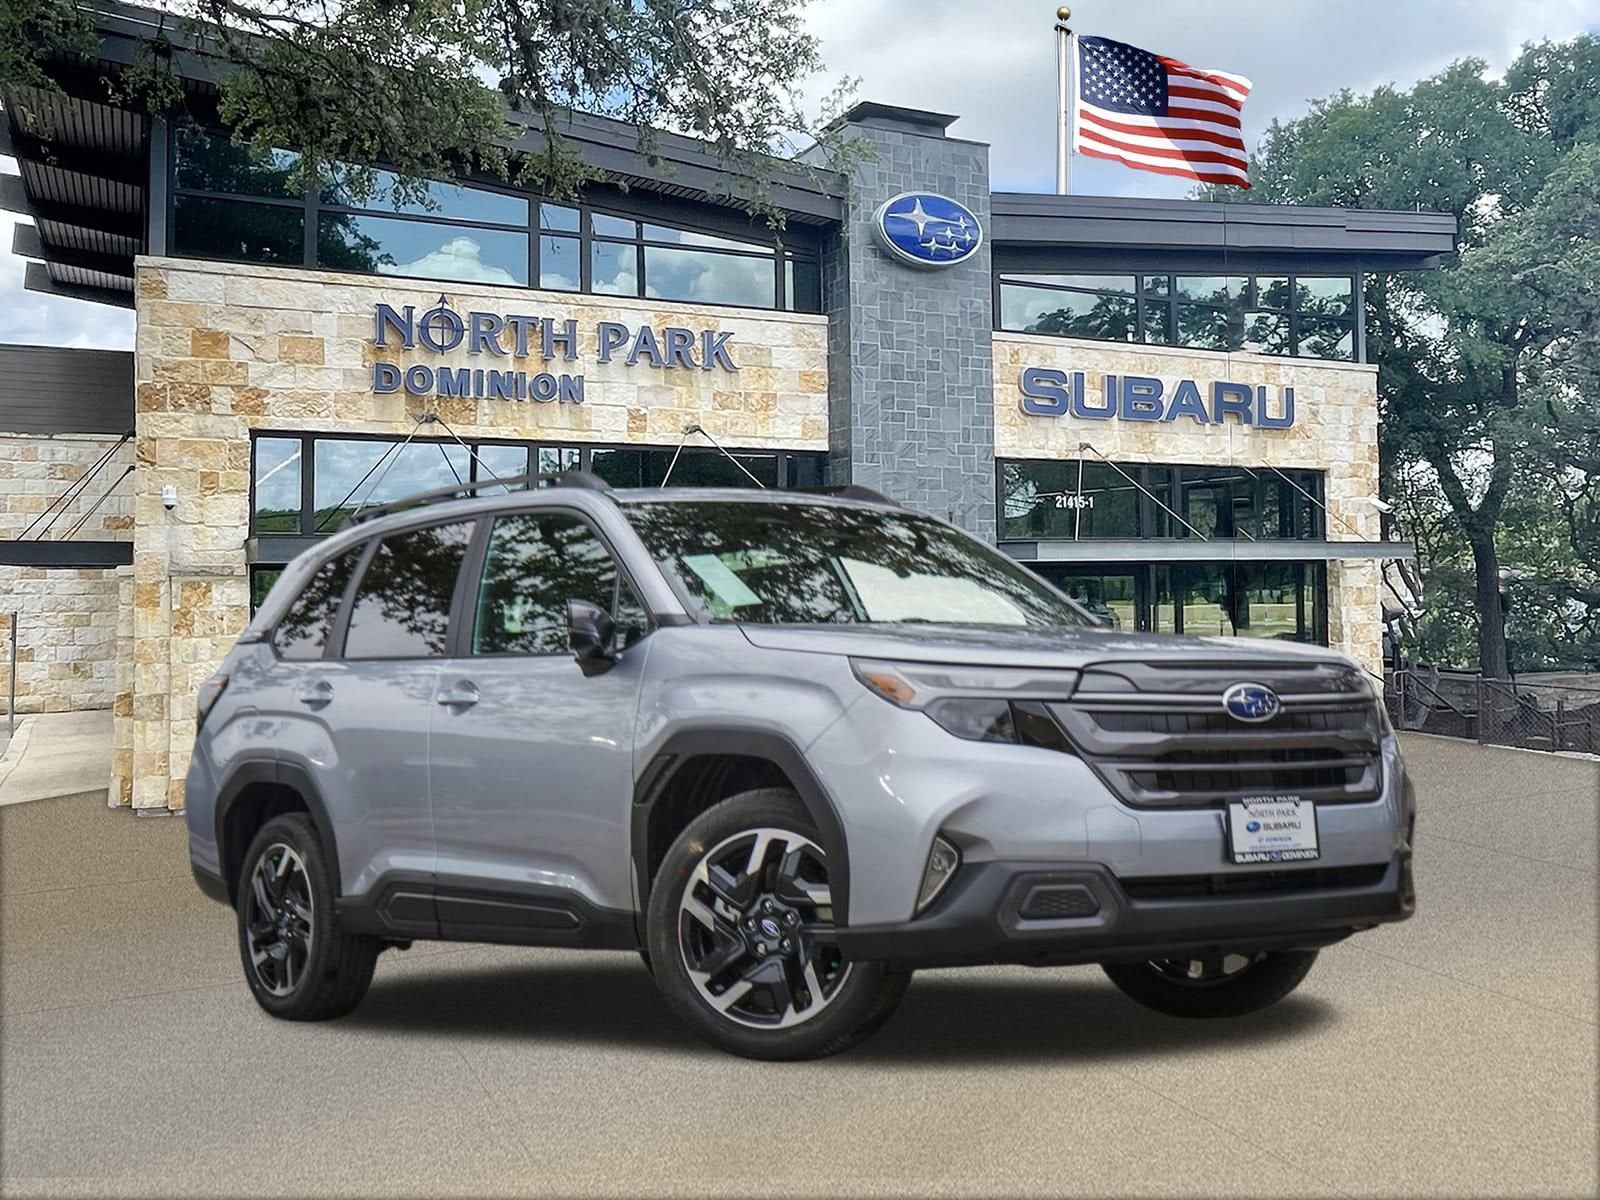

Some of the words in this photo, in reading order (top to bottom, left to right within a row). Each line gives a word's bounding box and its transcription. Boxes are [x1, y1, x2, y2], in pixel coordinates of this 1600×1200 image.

[374, 295, 578, 361] NORTH
[596, 321, 741, 373] PARK
[373, 362, 584, 404] DOMINION
[1019, 367, 1295, 430] SUBARU
[1055, 495, 1094, 509] 21415-1
[1248, 808, 1275, 818] NORTH
[1277, 808, 1298, 817] PARK
[1262, 821, 1302, 831] SUBARU
[1235, 852, 1270, 863] SUBARU
